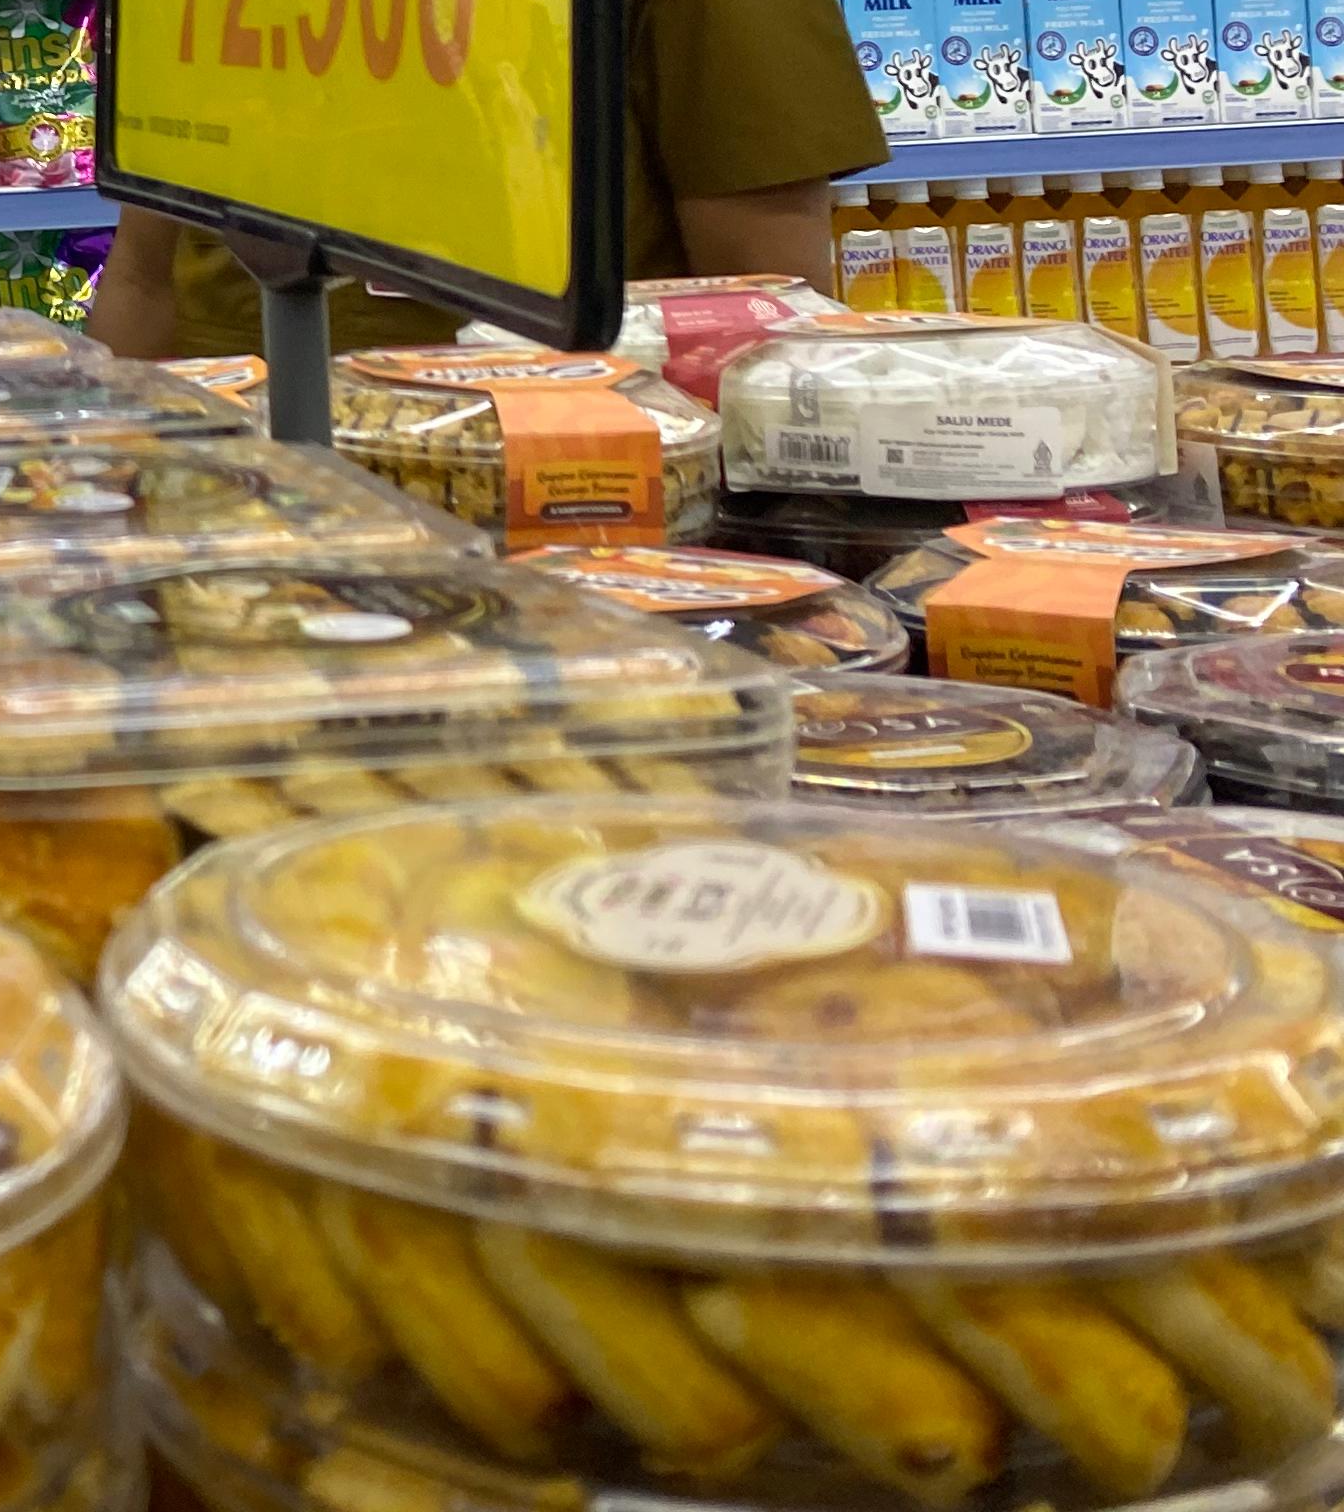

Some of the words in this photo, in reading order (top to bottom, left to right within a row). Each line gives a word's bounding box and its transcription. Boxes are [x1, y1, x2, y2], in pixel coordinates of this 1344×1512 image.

[911, 255, 949, 267] WATER
[967, 255, 1012, 270] WATER
[1025, 251, 1068, 265] WATER
[843, 261, 892, 276] WATER
[936, 415, 974, 427] SALJU
[977, 416, 1013, 428] MEDE
